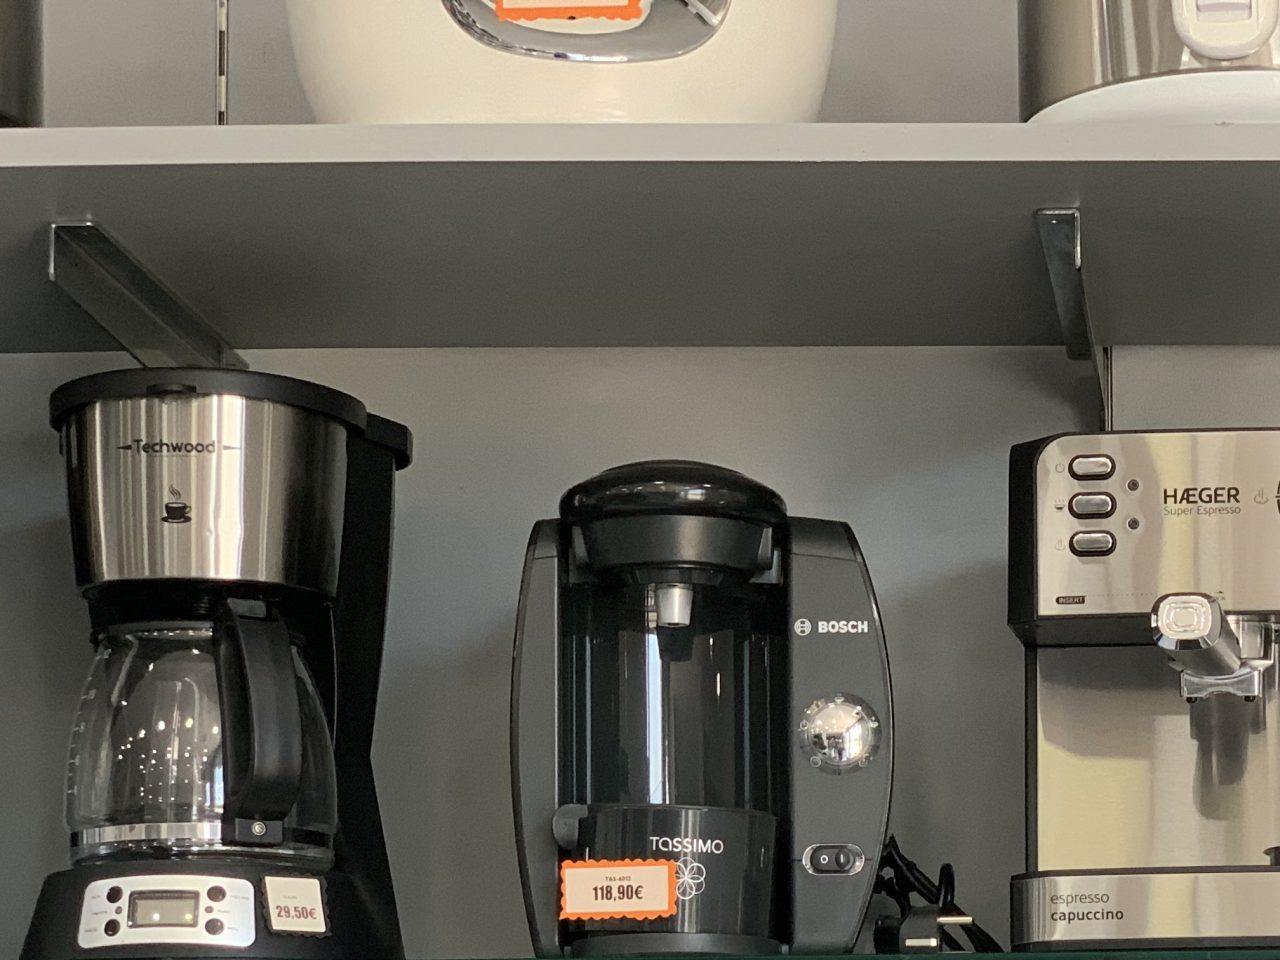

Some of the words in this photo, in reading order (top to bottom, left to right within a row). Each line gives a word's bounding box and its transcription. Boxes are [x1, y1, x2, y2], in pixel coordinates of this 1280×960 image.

[132, 439, 216, 454] Techwood
[1163, 487, 1240, 504] HÆGER
[1163, 505, 1194, 518] Super
[1197, 505, 1241, 517] Espresso
[818, 621, 868, 633] BOSCH
[593, 885, 644, 902] 118,90€
[1050, 893, 1110, 907] espresso
[275, 904, 317, 920] 29,50€
[1050, 908, 1125, 924] capuccino
